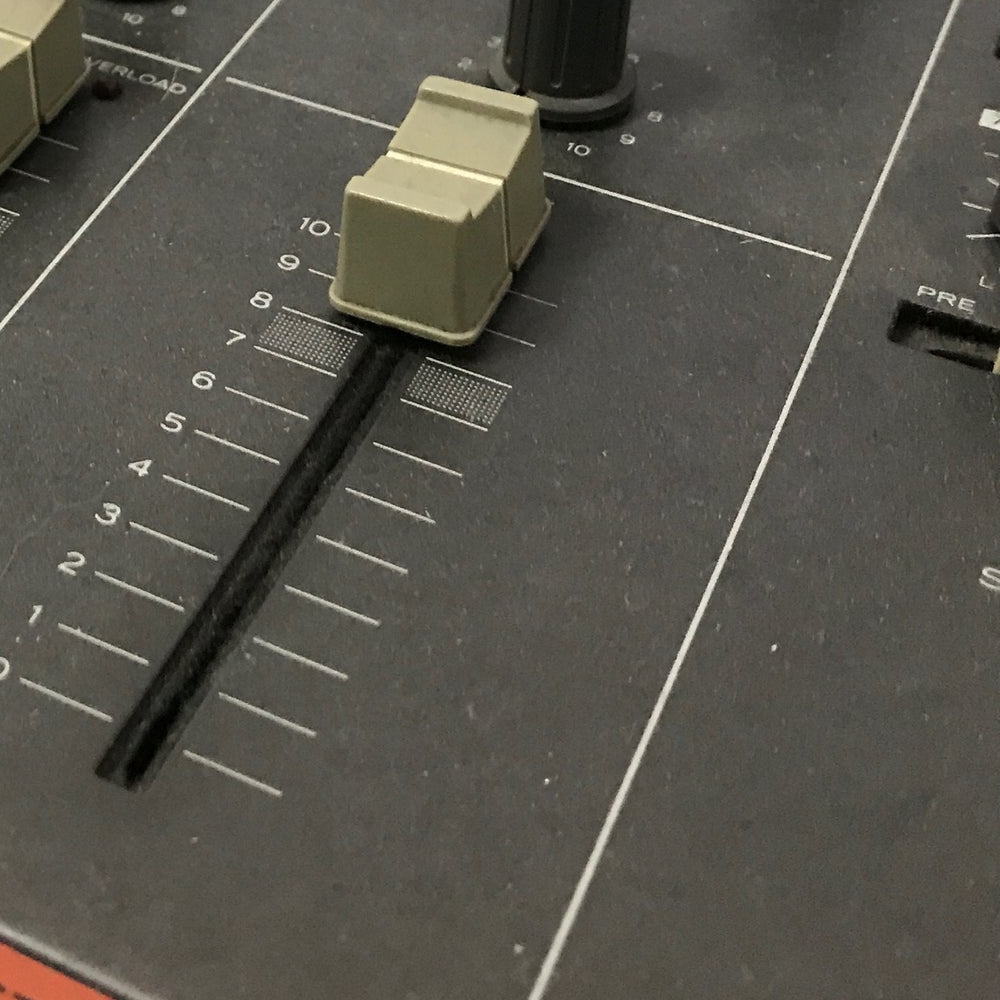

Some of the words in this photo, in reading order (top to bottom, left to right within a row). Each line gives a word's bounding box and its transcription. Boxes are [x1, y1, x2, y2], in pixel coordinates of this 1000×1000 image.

[84, 56, 188, 95] VERLOAD
[566, 142, 591, 157] 10
[300, 217, 331, 236] 10
[277, 254, 300, 271] 9
[250, 291, 273, 309] 8
[916, 285, 977, 315] PRE
[226, 329, 247, 346] 7
[192, 370, 216, 390] 6
[160, 411, 187, 433] 5
[127, 459, 152, 477] 4
[94, 502, 121, 526] 3
[57, 551, 86, 576] 2
[28, 604, 43, 625] 1
